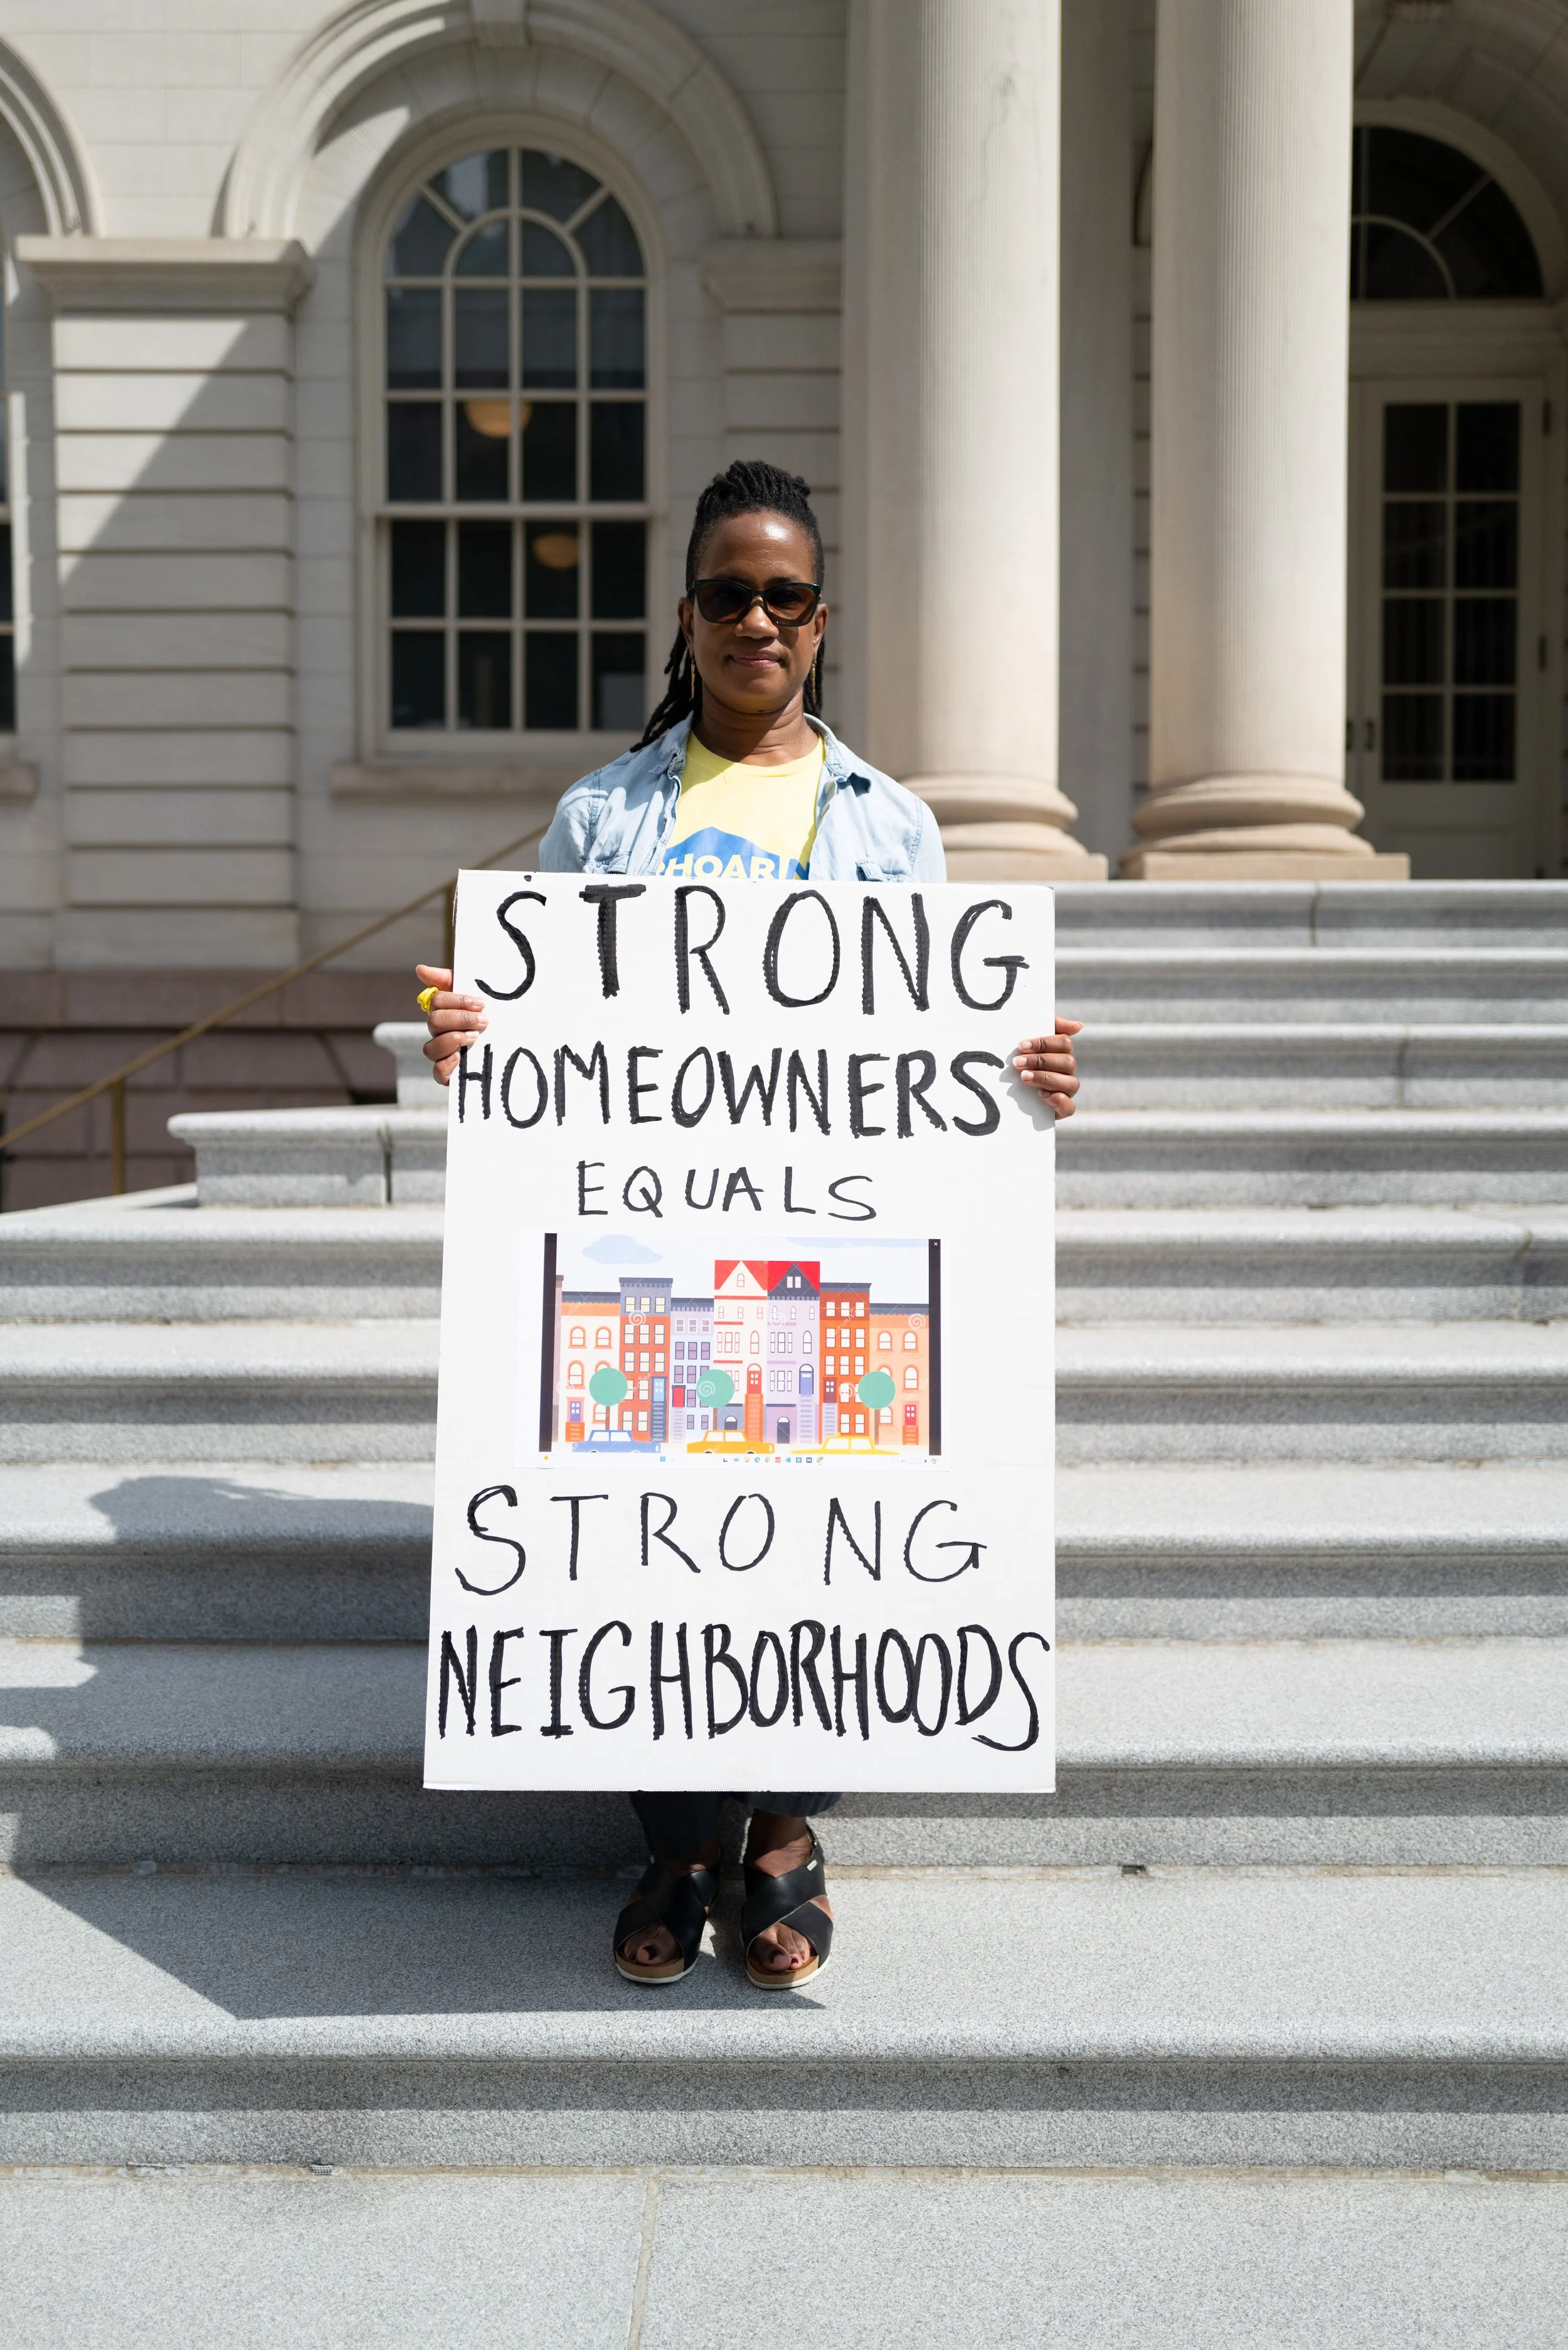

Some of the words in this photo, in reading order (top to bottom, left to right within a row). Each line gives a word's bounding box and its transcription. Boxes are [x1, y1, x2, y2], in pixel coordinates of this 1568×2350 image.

[474, 884, 1030, 1015] STRONG
[458, 1039, 1005, 1139] HOMEOWNERS
[576, 1160, 877, 1221] EQUALS
[455, 1484, 987, 1596] STRONG
[438, 1619, 1051, 1752] NEIGHBORHOODS
